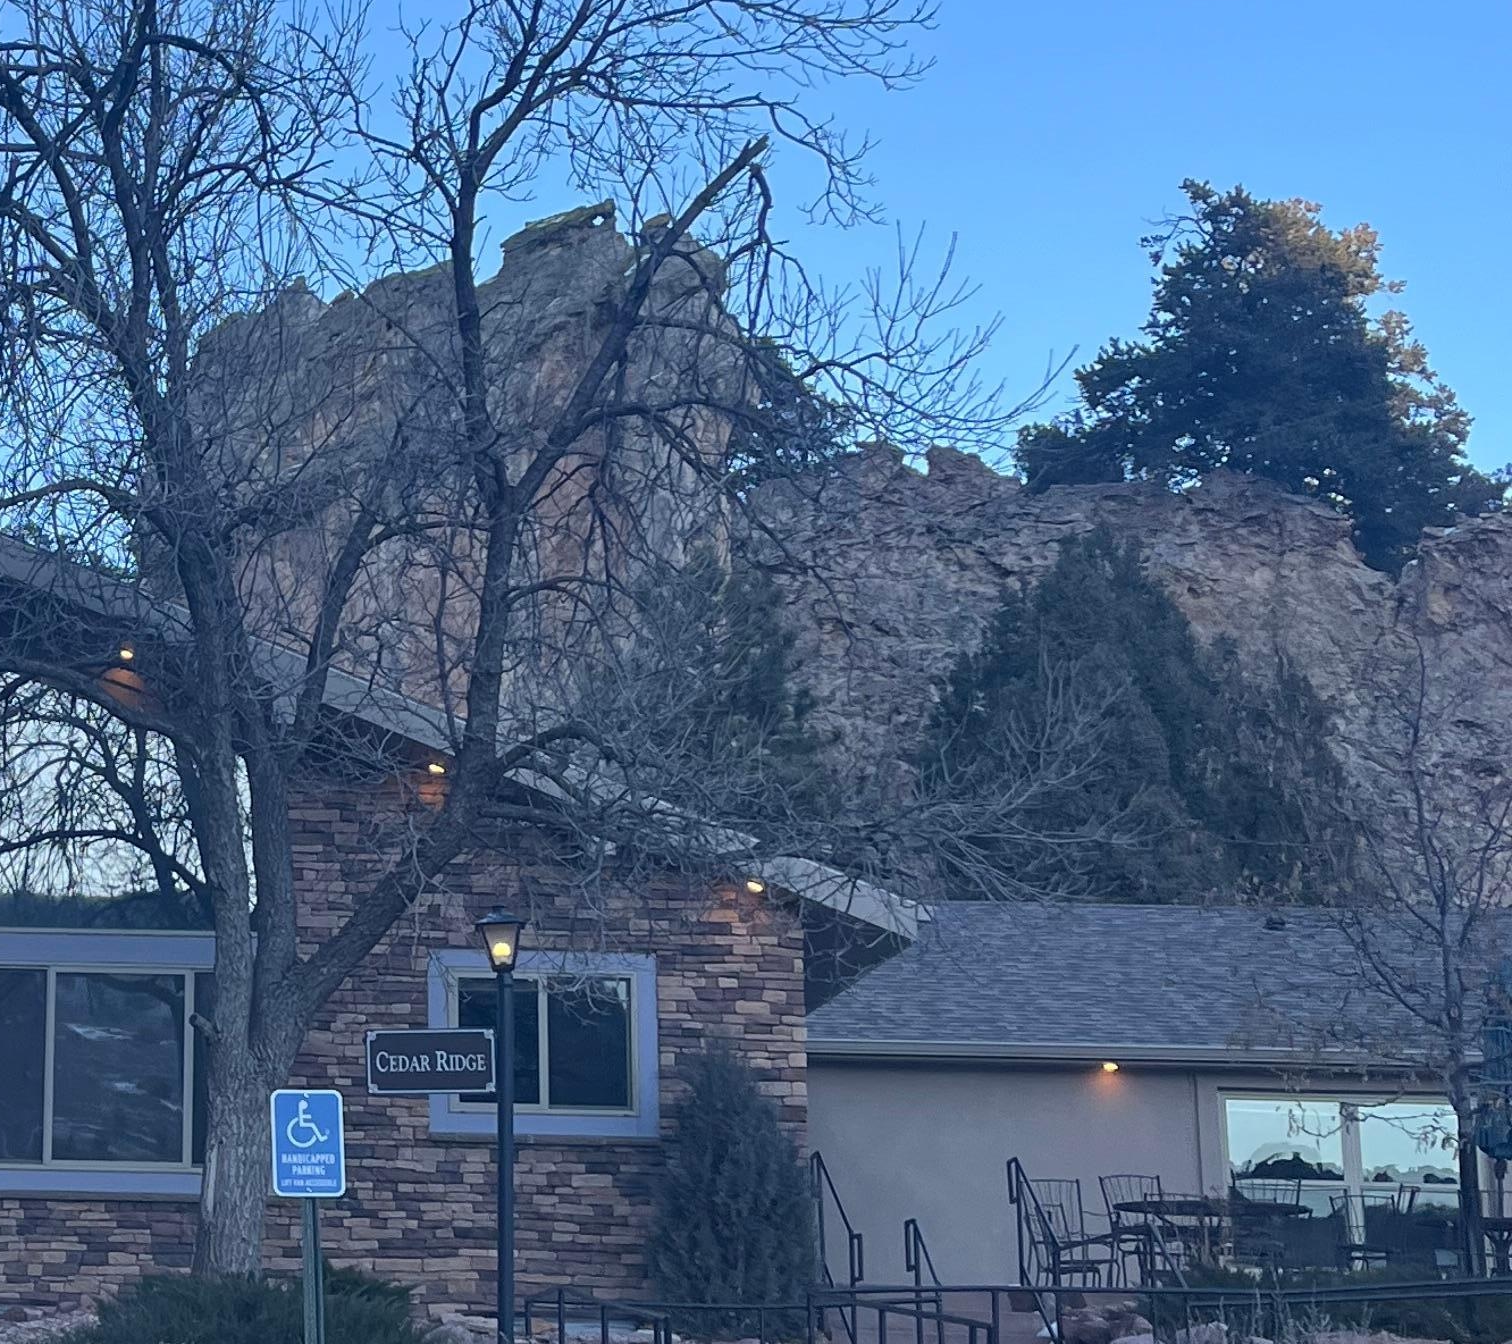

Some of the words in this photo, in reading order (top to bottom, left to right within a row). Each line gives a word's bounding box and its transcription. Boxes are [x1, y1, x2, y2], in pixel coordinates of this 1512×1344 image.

[375, 1051, 431, 1073] CEDAR
[435, 1050, 487, 1072] RIDGE
[281, 1152, 336, 1165] HANDICAPPED
[291, 1165, 326, 1176] PARKING
